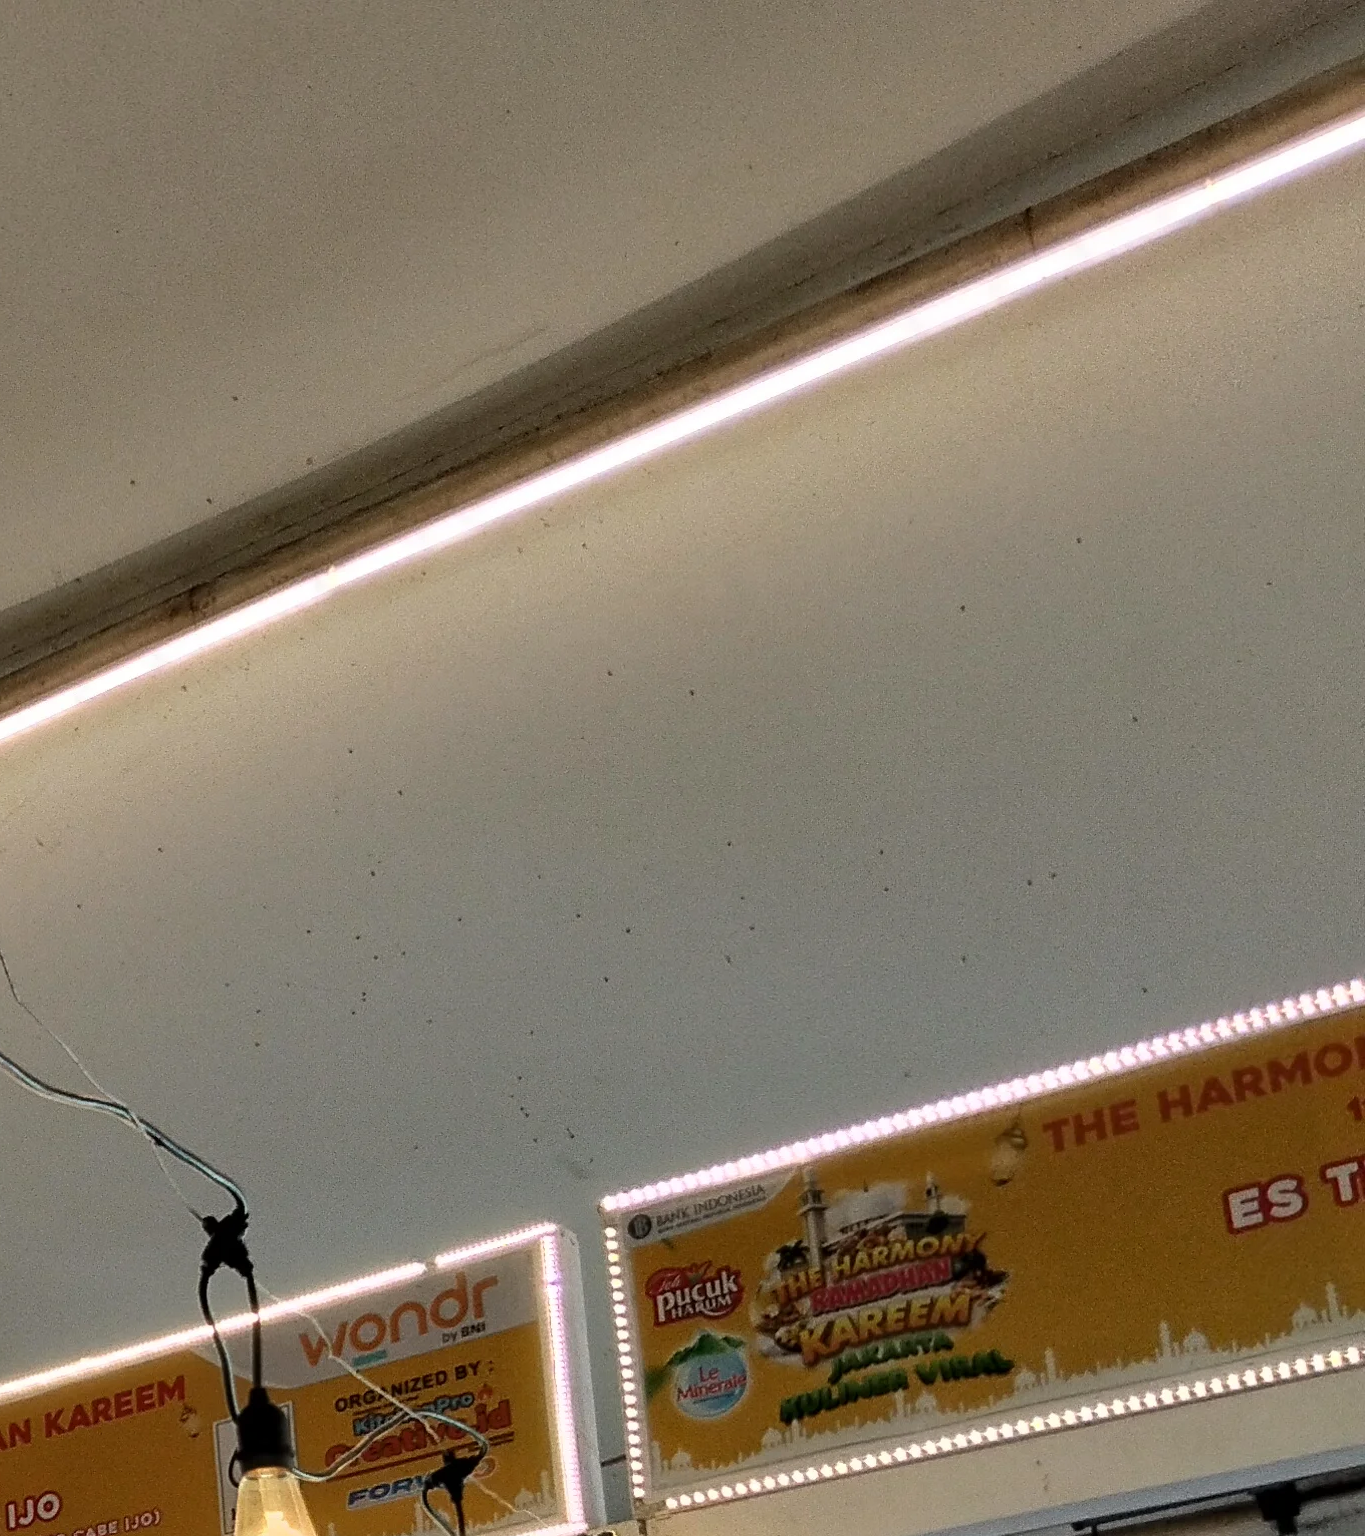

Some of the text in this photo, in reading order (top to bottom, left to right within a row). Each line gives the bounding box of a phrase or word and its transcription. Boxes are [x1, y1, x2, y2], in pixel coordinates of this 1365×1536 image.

[1042, 1100, 1140, 1152] THE
[655, 1206, 689, 1227] BANK
[693, 1183, 767, 1216] INDONESIA
[1228, 1158, 1365, 1230] ES T
[773, 1232, 988, 1304] THE HARMONY
[811, 1256, 953, 1313] RAMADHAN
[298, 1271, 499, 1369] wondr
[656, 1270, 739, 1322] pucuk
[671, 1294, 733, 1319] HARUM
[442, 1330, 457, 1345] by
[799, 1294, 971, 1368] KAREEM
[334, 1369, 448, 1413] ORGANIZED
[455, 1359, 481, 1381] BY
[677, 1372, 748, 1402] Minerale
[699, 1365, 720, 1383] Le
[44, 1374, 186, 1438] KAREEM
[7, 1492, 62, 1530] IJO
[124, 1508, 162, 1531] IJO)
